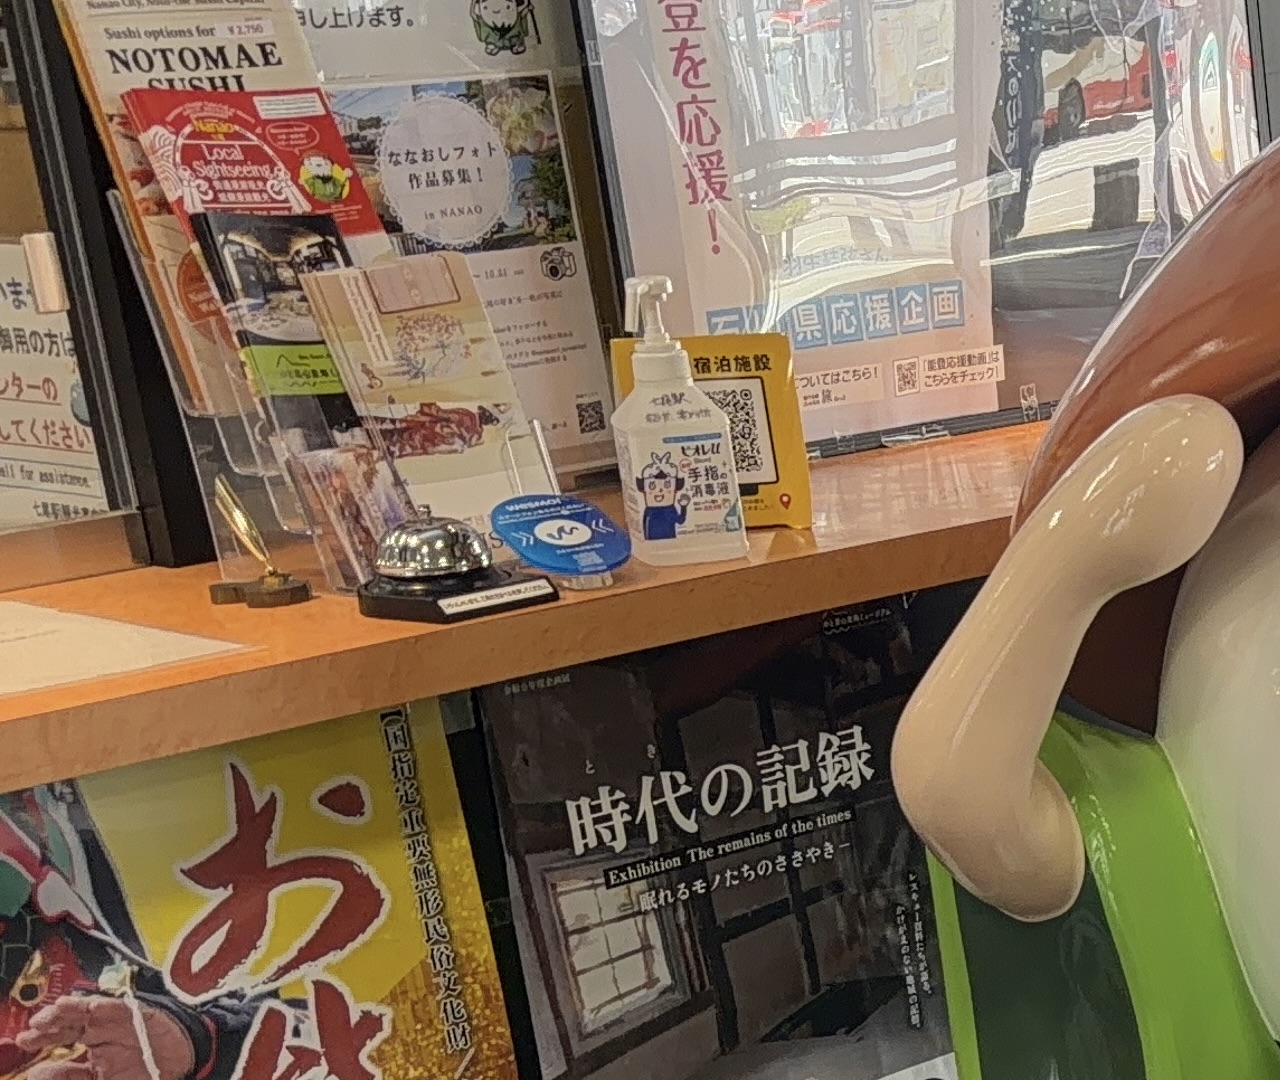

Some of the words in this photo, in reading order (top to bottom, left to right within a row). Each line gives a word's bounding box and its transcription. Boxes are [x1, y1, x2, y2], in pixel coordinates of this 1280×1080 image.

[104, 27, 141, 40] Sushi
[144, 25, 193, 42] options
[197, 23, 215, 38] for
[105, 41, 283, 75] NOTOMAE
[201, 144, 245, 161] Local
[387, 142, 497, 166] ななおしフォト
[192, 161, 274, 178] Sightseeing
[441, 205, 483, 219] NANAO
[693, 354, 772, 373] 宿泊施設
[565, 725, 876, 856] 時代の記録
[608, 854, 682, 887] Exhibition
[687, 845, 716, 865] The
[717, 830, 772, 858] remains
[774, 822, 790, 840] of
[791, 815, 814, 836] the
[817, 808, 853, 830] times
